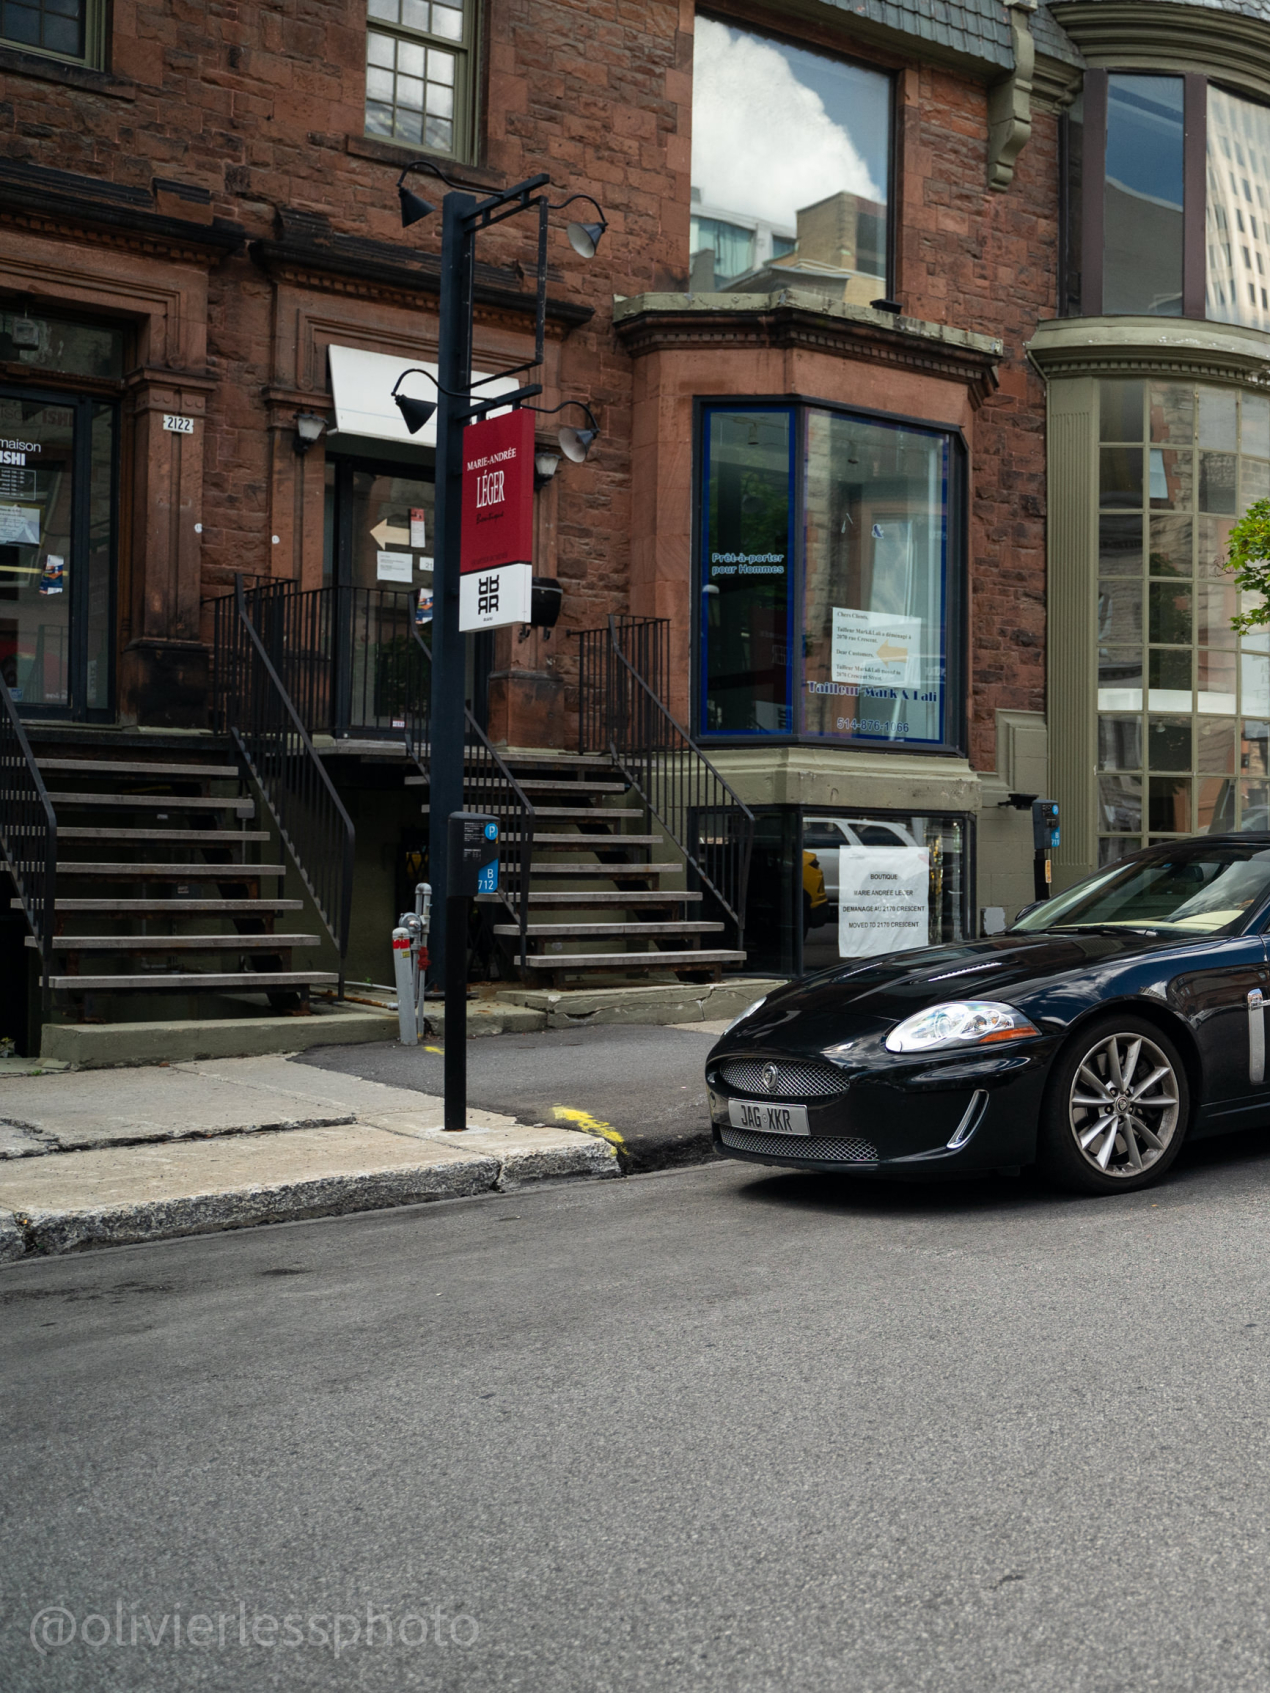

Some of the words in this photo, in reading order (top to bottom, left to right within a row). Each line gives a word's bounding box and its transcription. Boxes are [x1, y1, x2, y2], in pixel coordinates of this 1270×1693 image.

[168, 416, 191, 431] 2122
[467, 447, 517, 472] MARIE-ANDRÉE
[476, 469, 506, 509] LÉGER
[871, 523, 885, 539] &
[712, 552, 785, 565] Prêt-à-porter
[712, 566, 737, 577] pour
[738, 564, 785, 574] Hommes
[806, 680, 860, 697] Tailleur
[864, 686, 898, 699] Mark
[836, 717, 910, 733] 514-876-1066
[487, 868, 494, 879] B
[477, 879, 494, 891] 712
[741, 1105, 762, 1128] JAG
[767, 1108, 792, 1131] XKR
